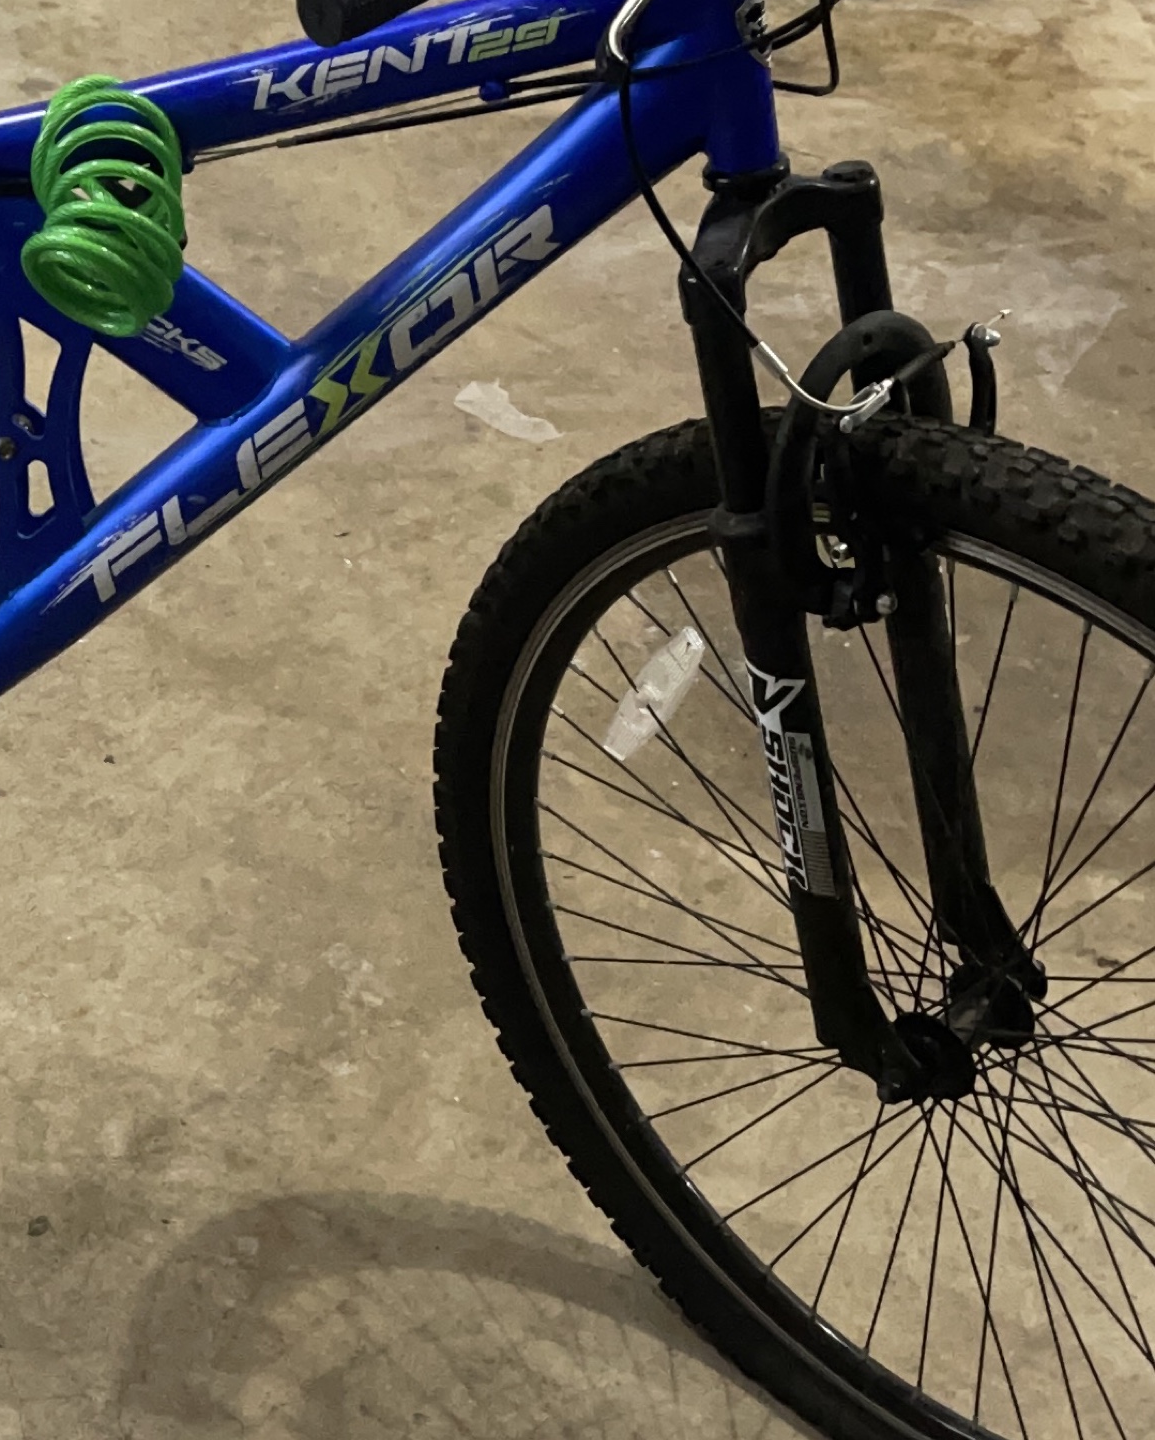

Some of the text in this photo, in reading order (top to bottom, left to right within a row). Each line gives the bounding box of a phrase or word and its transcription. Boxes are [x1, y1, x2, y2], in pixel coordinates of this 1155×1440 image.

[69, 203, 564, 604] FLEXOR
[144, 314, 229, 371] CKS
[760, 723, 809, 892] SHOCK
